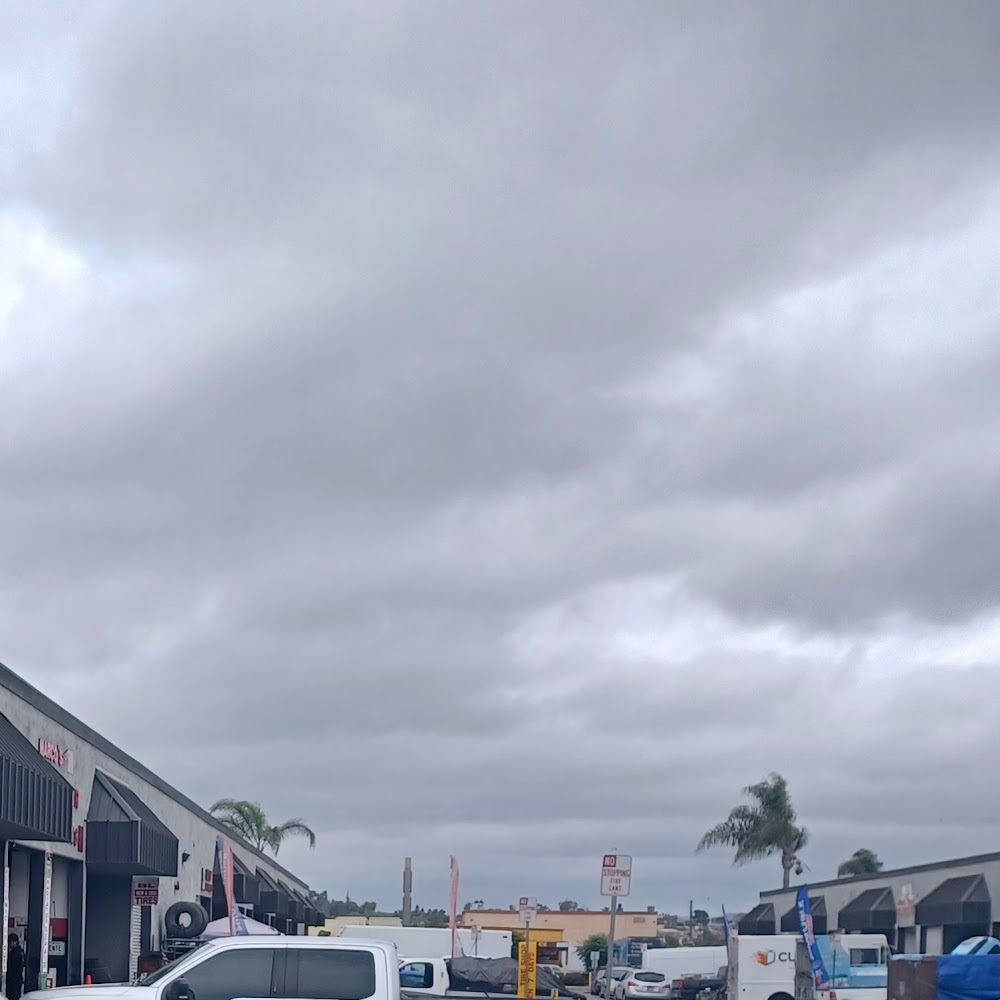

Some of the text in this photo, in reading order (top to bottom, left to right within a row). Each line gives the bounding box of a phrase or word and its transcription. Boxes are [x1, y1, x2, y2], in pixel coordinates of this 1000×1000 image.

[604, 856, 615, 866] NO
[603, 869, 630, 877] STOPPING
[135, 896, 158, 905] TIRES
